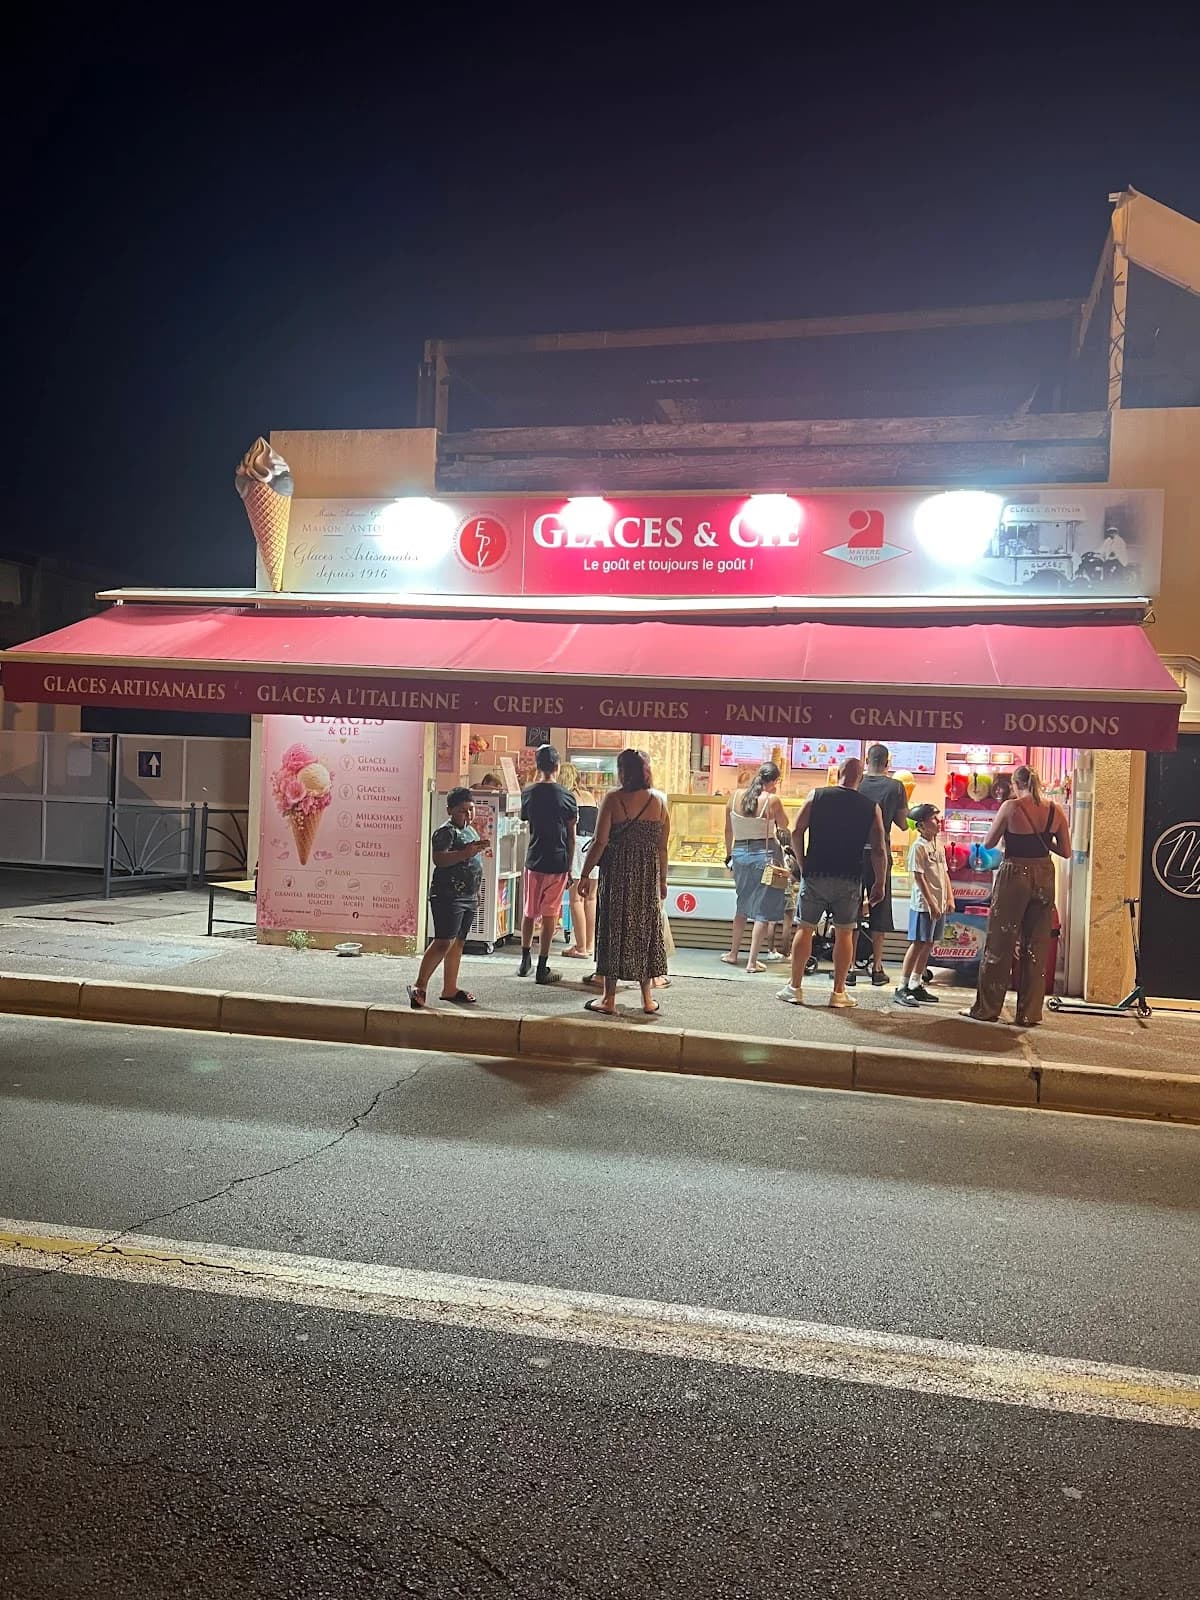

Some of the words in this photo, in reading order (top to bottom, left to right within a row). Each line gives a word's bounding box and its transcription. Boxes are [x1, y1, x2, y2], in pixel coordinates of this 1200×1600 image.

[693, 522, 719, 547] &
[583, 558, 598, 571] Le
[602, 557, 630, 573] goût
[633, 559, 645, 571] et
[648, 558, 698, 573] toujours
[702, 558, 713, 571] le
[717, 557, 746, 573] goût
[750, 559, 754, 571] !
[43, 675, 106, 695] GLACES
[110, 679, 226, 701] ARTISANALES
[256, 684, 326, 705] GLACES
[329, 688, 343, 705] A
[346, 688, 461, 710] L'ITALIENNE
[493, 695, 565, 715] CREPES
[599, 698, 690, 721] GAUFRES
[725, 702, 813, 724] PANINIS
[849, 707, 965, 730] GRANITES
[1003, 712, 1121, 736] BOISSONS
[328, 727, 336, 736] &
[339, 727, 360, 736] CIE
[356, 813, 404, 822] MILKSHAKES
